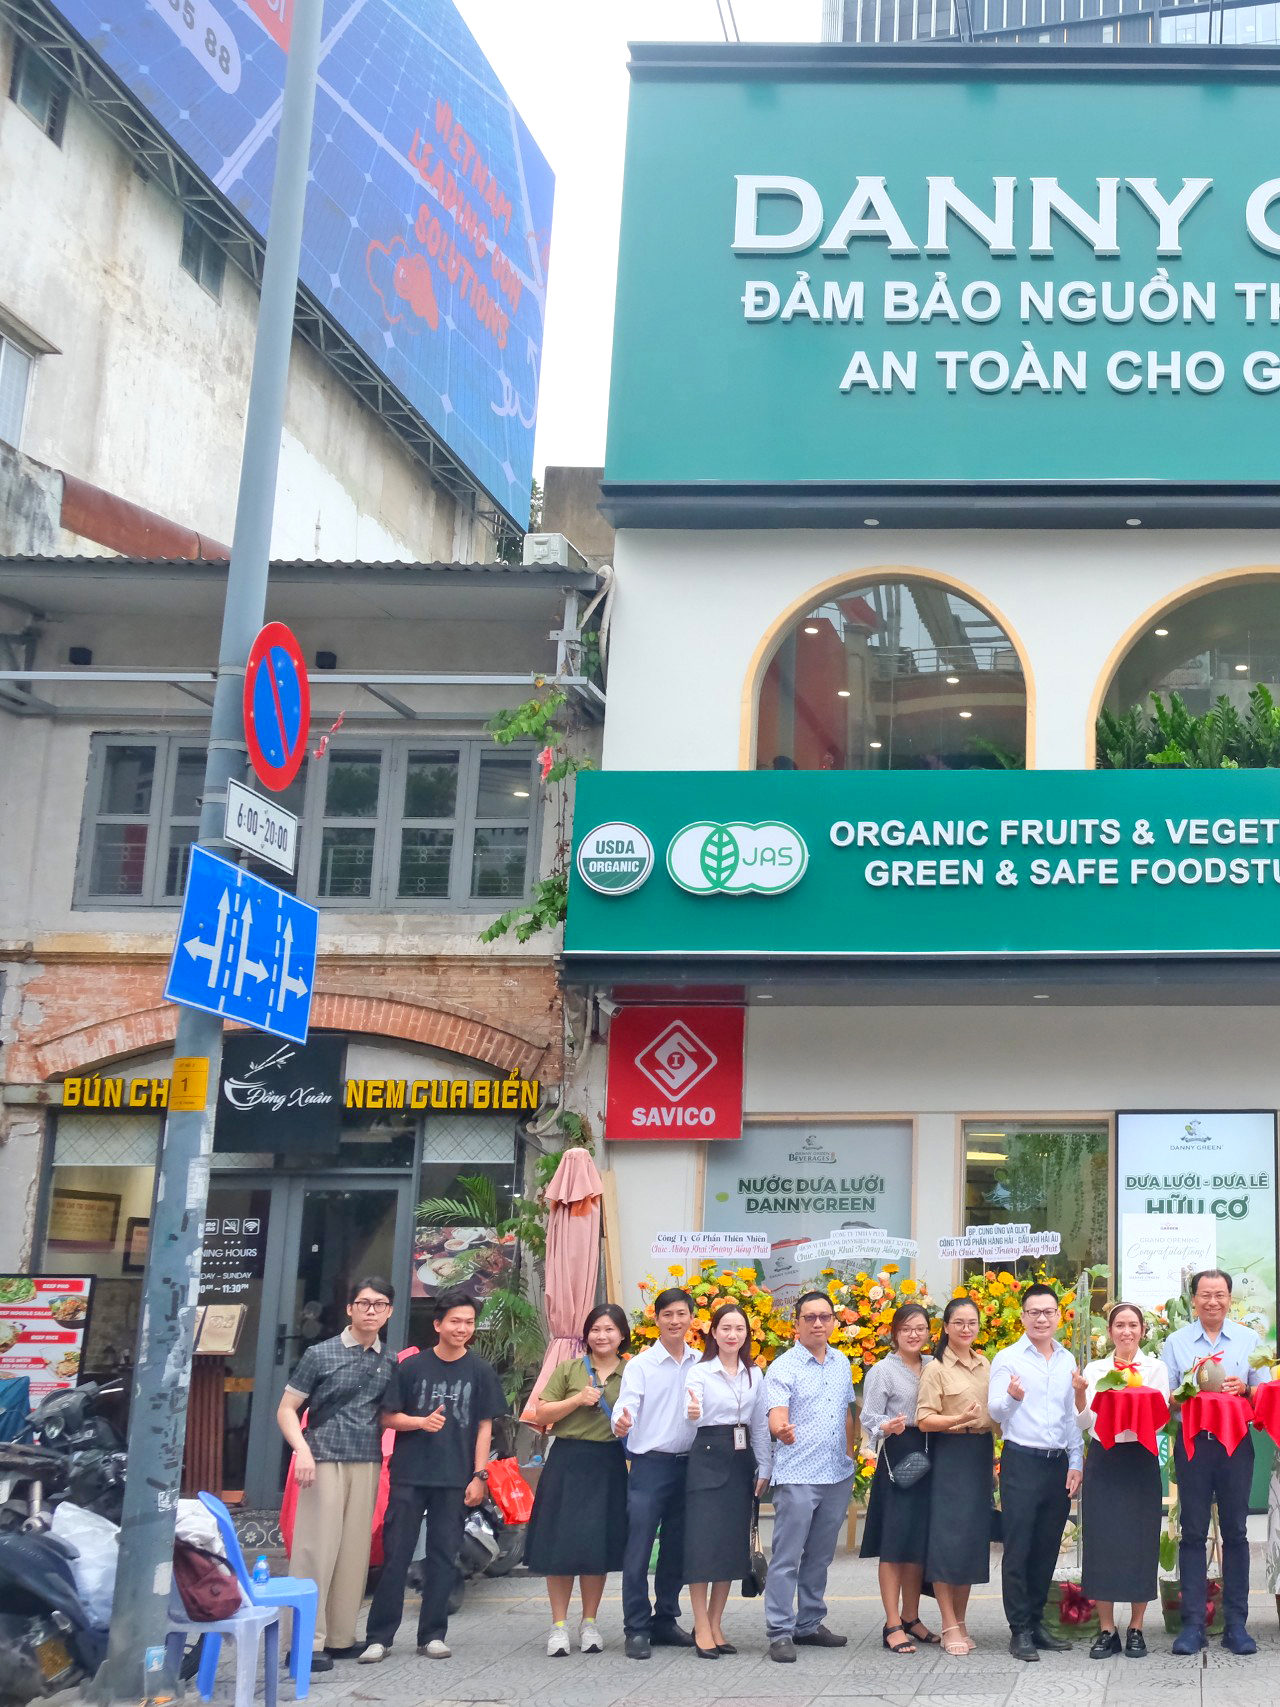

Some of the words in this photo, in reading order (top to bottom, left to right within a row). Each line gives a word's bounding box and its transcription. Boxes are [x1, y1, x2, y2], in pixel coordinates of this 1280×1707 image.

[204, 27, 231, 75] 88
[436, 97, 513, 236] VIETNAM
[408, 128, 488, 259] LEADING
[730, 175, 1213, 257] DANNY
[414, 204, 510, 350] SOLUTIONS
[741, 270, 865, 322] ĐẢM
[884, 271, 1002, 323] BẢO
[1019, 267, 1216, 323] NGUỒN
[838, 350, 917, 392] AN
[935, 340, 1087, 393] TOÀN
[1106, 350, 1225, 393] CHO
[829, 819, 989, 848] ORGANIC
[1000, 818, 1121, 846] FRUITS
[1132, 818, 1155, 845] &
[595, 840, 635, 855] USDA
[742, 846, 793, 866] JAS
[588, 860, 640, 874] ORGANIC
[864, 858, 984, 887] GREEN
[995, 859, 1019, 886] &
[1029, 858, 1119, 886] SAFE
[63, 1073, 123, 1107] BÚN
[128, 1078, 171, 1107] CH
[181, 1077, 188, 1092] 1
[346, 1079, 406, 1109] NEM
[410, 1080, 467, 1109] CUA
[473, 1067, 540, 1109] BIỂN
[246, 1088, 286, 1111] Đồng
[289, 1087, 334, 1106] Xuân
[631, 1106, 716, 1126] SAVICO
[738, 1174, 794, 1195] NƯỚC
[797, 1174, 837, 1194] DƯA
[841, 1174, 885, 1194] LƯỚI
[1126, 1173, 1162, 1189] DƯA
[1163, 1173, 1201, 1189] LƯỚI
[1212, 1172, 1248, 1189] DƯA
[1250, 1172, 1270, 1189] LÊ
[745, 1196, 876, 1213] DANNYGREEN
[1210, 1195, 1249, 1219] CƠ
[657, 1234, 676, 1243] Công
[679, 1235, 687, 1244] Ty
[225, 1248, 257, 1257] HOURS
[222, 1271, 253, 1279] SUNDAY
